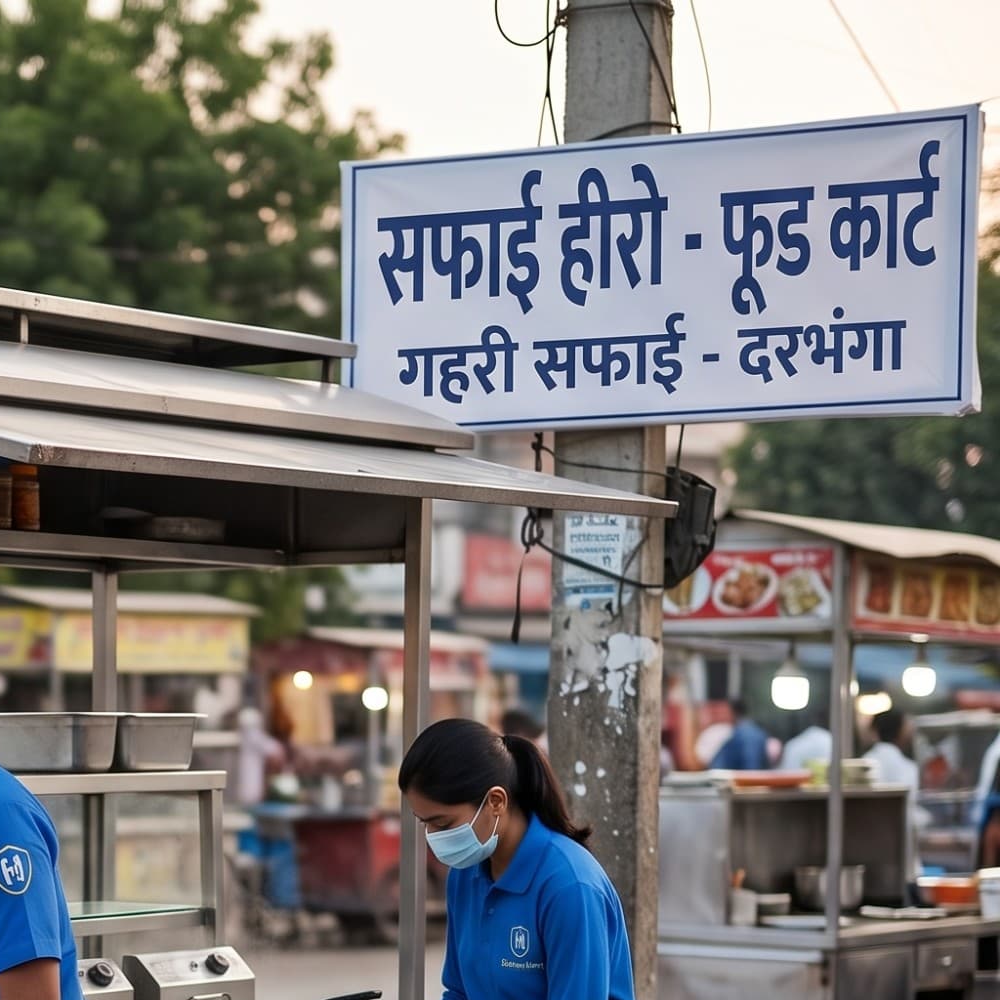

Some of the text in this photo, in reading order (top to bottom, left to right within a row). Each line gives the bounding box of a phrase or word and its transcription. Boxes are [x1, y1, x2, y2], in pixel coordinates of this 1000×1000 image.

[376, 168, 542, 314] सफाई
[558, 163, 669, 307] हीरो
[720, 186, 815, 315] फूड
[828, 140, 941, 271] कार्ट
[397, 324, 519, 404] गहरी
[532, 311, 687, 394] सफाई
[737, 306, 907, 384] दरभंगा
